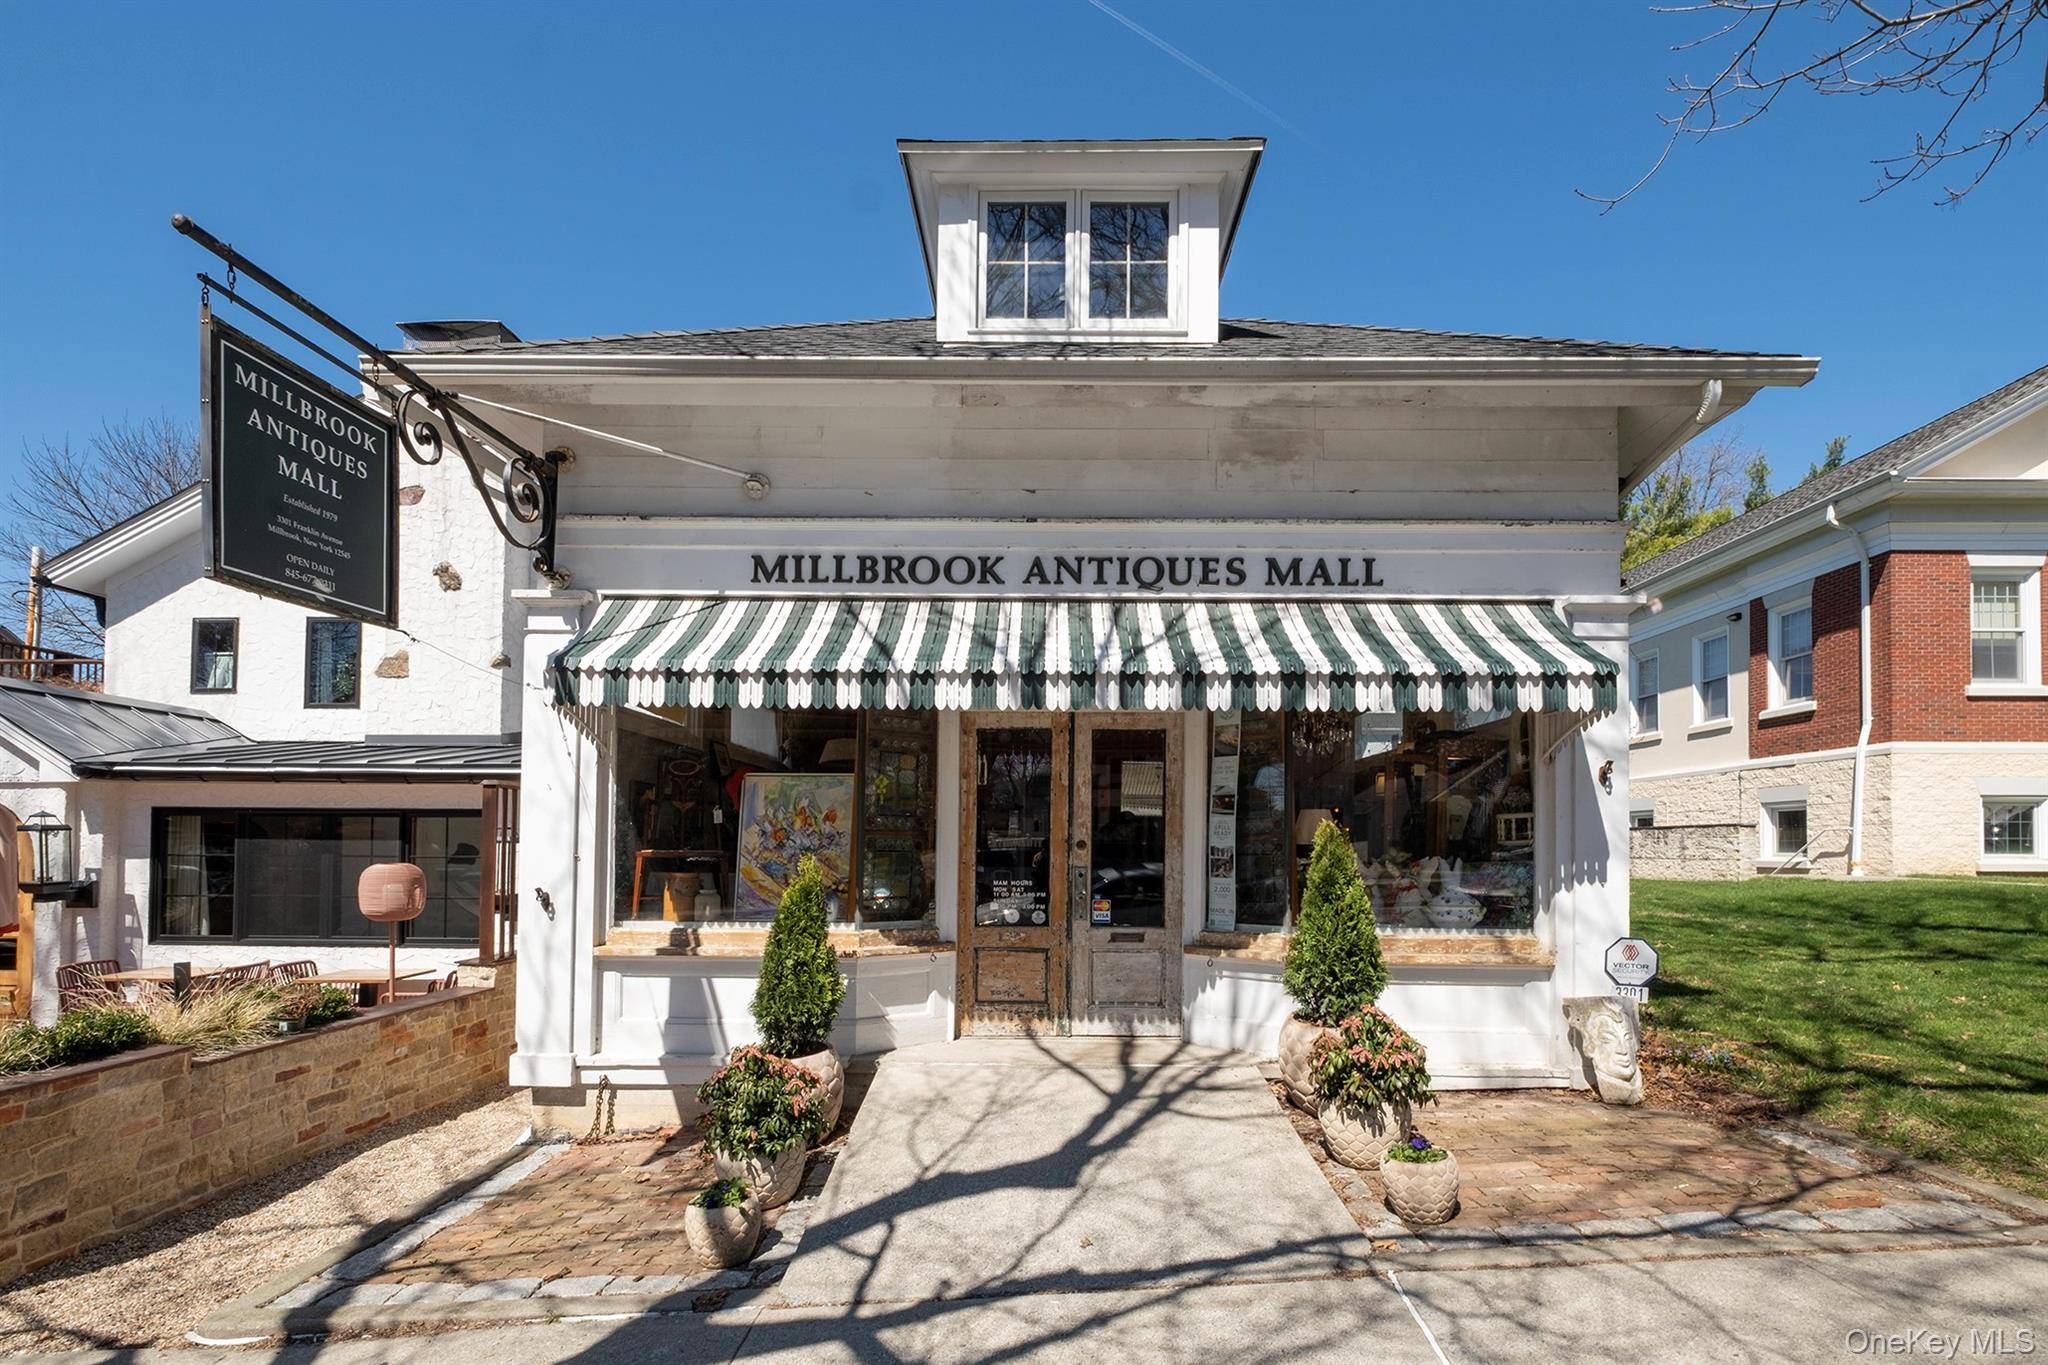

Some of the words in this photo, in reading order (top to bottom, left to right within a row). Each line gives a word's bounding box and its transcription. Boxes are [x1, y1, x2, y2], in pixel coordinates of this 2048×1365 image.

[234, 363, 377, 454] MILLBROOK
[247, 408, 368, 479] ANTIQUES
[278, 455, 342, 500] MALL
[283, 494, 320, 516] Established
[322, 510, 338, 522] 1979
[303, 537, 318, 548] New
[319, 542, 333, 554] York
[286, 554, 310, 568] OPEN
[312, 562, 336, 576] DAILY
[750, 555, 1006, 584] MILLBROOK
[1022, 556, 1247, 593] ANTIQUES
[1264, 557, 1384, 587] MALL
